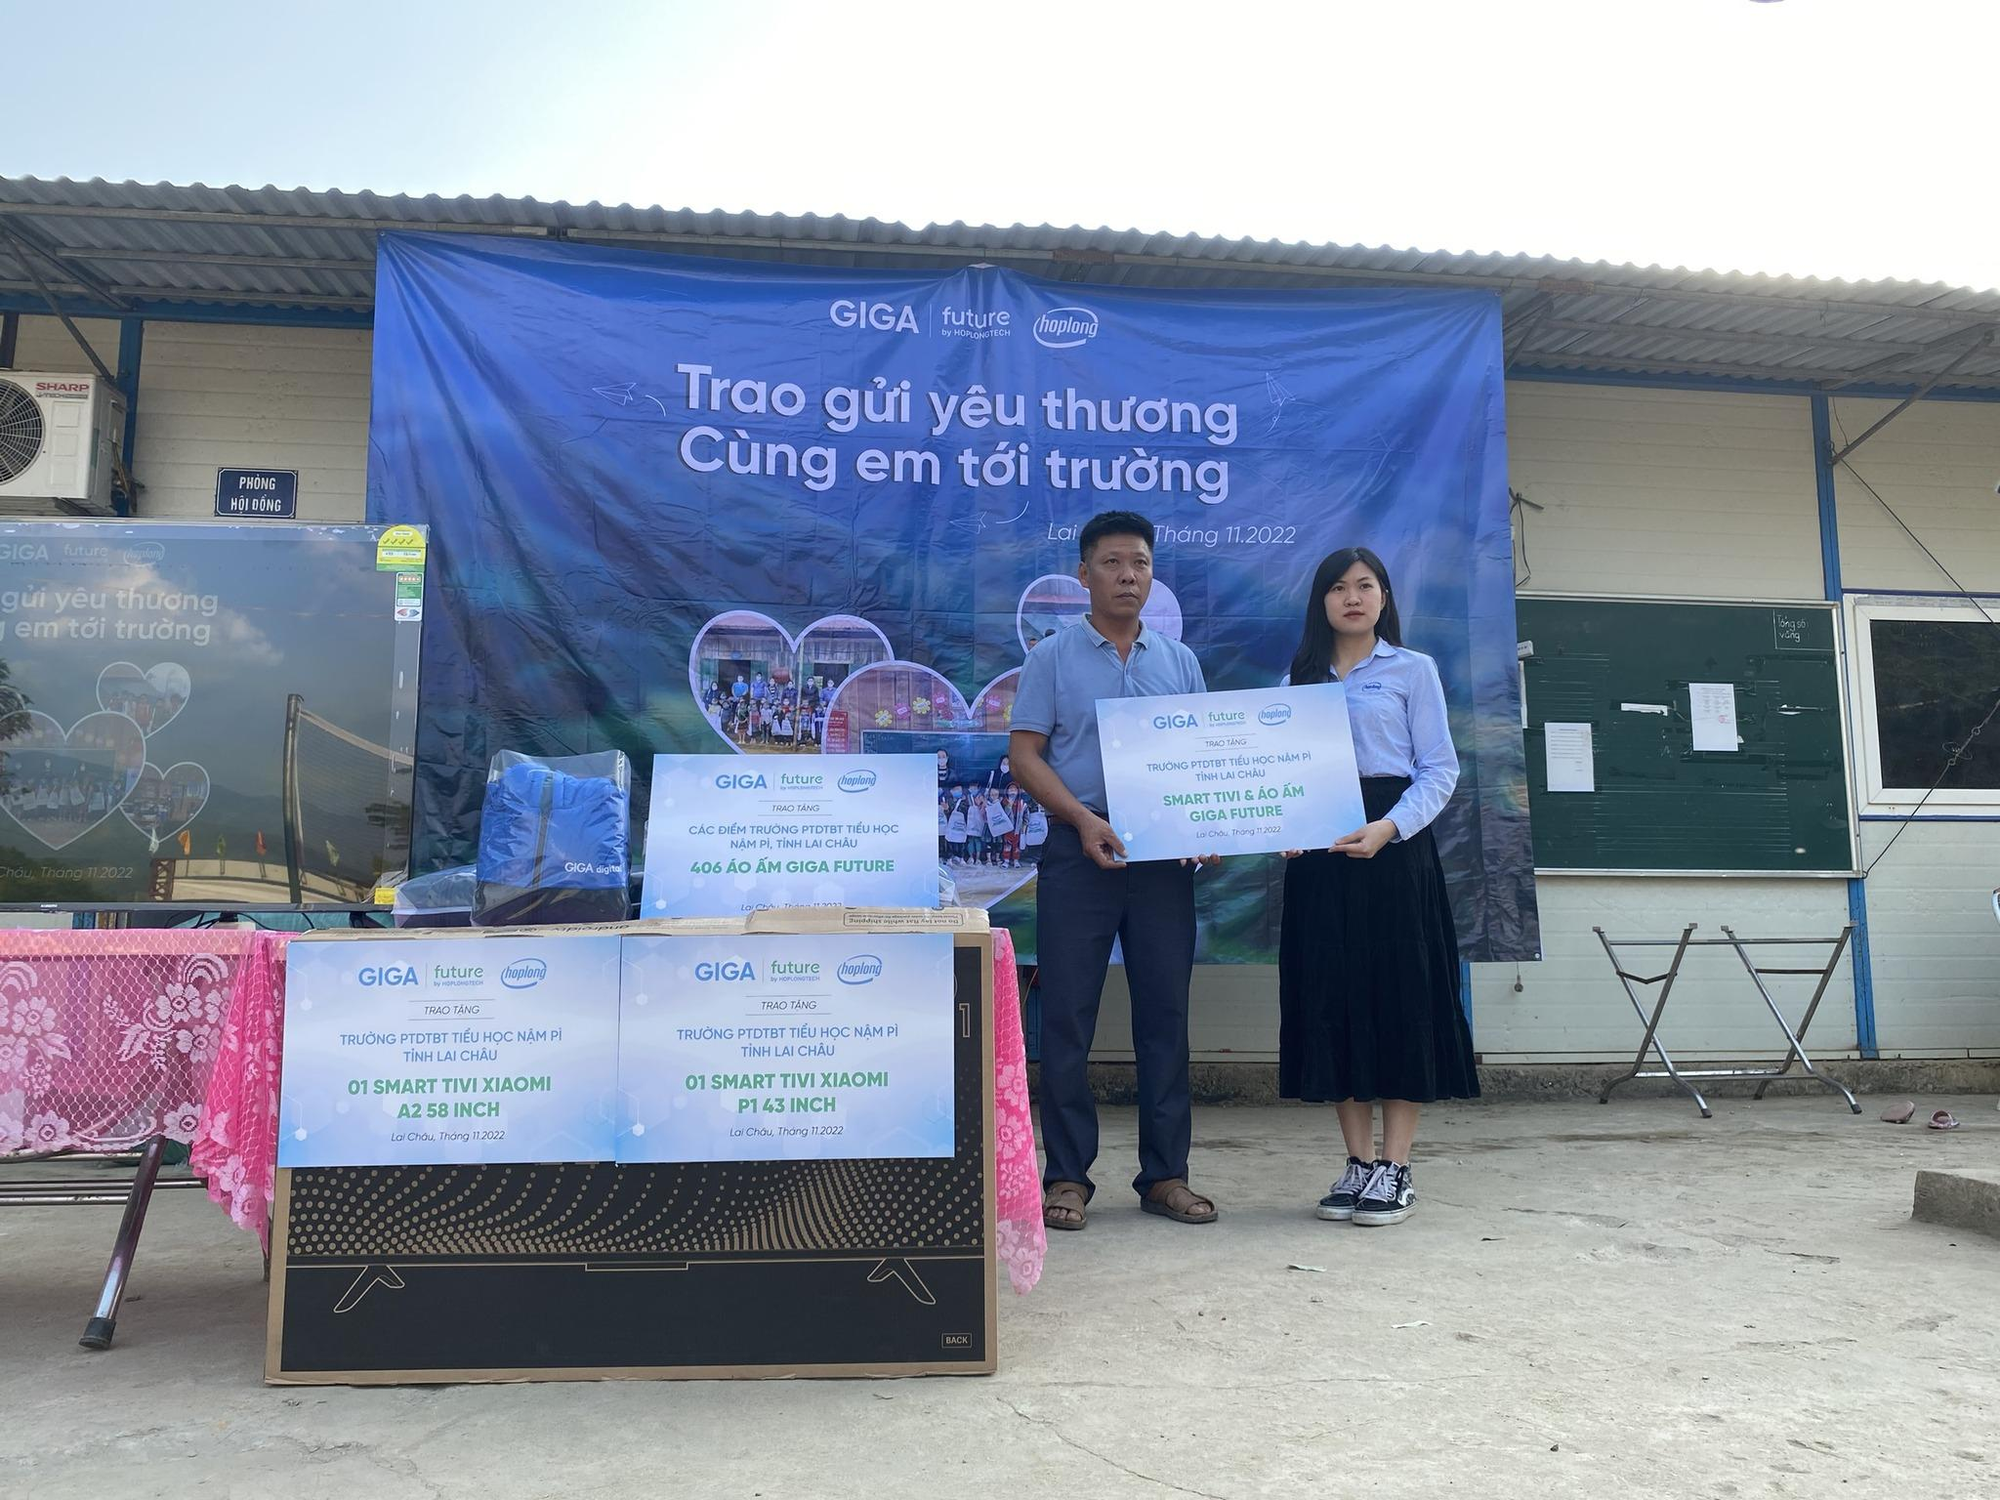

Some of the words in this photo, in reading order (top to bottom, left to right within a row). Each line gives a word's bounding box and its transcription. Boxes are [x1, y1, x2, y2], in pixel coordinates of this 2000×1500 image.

[829, 299, 920, 334] GIGA
[942, 306, 1011, 329] future
[942, 329, 952, 338] by
[953, 329, 1011, 340] HOPLONGTECH
[1038, 316, 1099, 338] hoplong
[35, 382, 90, 392] SHARP
[677, 363, 806, 416] Trao
[823, 376, 911, 433] gửi
[928, 384, 1025, 436] yêu
[1041, 387, 1237, 446] thương
[680, 425, 837, 492] Cùng
[856, 449, 941, 485] em
[958, 441, 1029, 487] tới
[1045, 447, 1229, 504] trường
[239, 473, 276, 490] PHÒNG
[230, 494, 249, 514] HỘI
[252, 493, 282, 512] ĐỒNG
[1047, 522, 1078, 541] Lai
[1153, 524, 1219, 548] Tháng
[1226, 525, 1297, 544] 11.2022
[64, 543, 109, 558] future
[1, 584, 46, 614] gửi
[55, 587, 106, 614] yêu
[115, 588, 219, 617] thương
[15, 620, 59, 639] em
[68, 616, 106, 640] tới
[115, 617, 211, 646] trường
[1153, 713, 1199, 730] GIGA
[1208, 711, 1246, 722] future
[1260, 708, 1292, 720] hoplong
[1205, 740, 1225, 748] TRAO
[1146, 761, 1189, 773] TRƯỜNG
[1190, 758, 1227, 770] PTDTBT
[715, 774, 768, 790] GIGA
[780, 772, 824, 785] future
[840, 774, 877, 788] hoplong
[1220, 770, 1235, 781] LAI
[1237, 768, 1266, 779] CHÂU
[1163, 792, 1211, 807] SMART
[1213, 790, 1241, 804] TIVI
[1244, 789, 1254, 801] &
[1257, 785, 1279, 800] ÁO
[1282, 781, 1305, 798] ẤM
[772, 804, 795, 813] TRAO
[1189, 808, 1228, 823] GIGA
[1230, 805, 1284, 820] FUTURE
[688, 823, 715, 836] CÁC
[718, 821, 747, 835] ĐIỂM
[750, 823, 799, 835] TRƯỜNG
[801, 824, 844, 835] PTDTBT
[846, 821, 870, 834] TIỂU
[873, 823, 899, 836] HỌC
[1196, 831, 1207, 839] Lai
[730, 837, 757, 851] NẬM
[805, 838, 822, 849] LAI
[825, 837, 858, 849] CHÂU
[40, 866, 82, 882] Tháng
[87, 866, 134, 879] 11.2022
[564, 862, 594, 873] GIGA
[690, 860, 723, 875] 406
[726, 858, 752, 875] ÁO
[755, 857, 782, 874] ẤM
[786, 860, 830, 874] GIGA
[833, 859, 895, 873] FUTURE
[433, 964, 484, 979] future
[503, 965, 547, 981] hoplong
[694, 961, 756, 982] GIGA
[770, 960, 821, 974] future
[840, 961, 883, 977] hoplong
[358, 965, 419, 987] GIGA
[424, 1006, 451, 1015] TRAO
[453, 1004, 481, 1017] TẶNG
[761, 1001, 788, 1010] TRAO
[790, 999, 817, 1012] TẶNG
[958, 1002, 970, 1038] 1
[340, 1030, 397, 1046] TRƯỜNG
[400, 1032, 449, 1045] PTDTBT
[451, 1028, 479, 1044] TIỂU
[483, 1031, 514, 1046] HỌC
[517, 1028, 547, 1045] NẬM
[676, 1025, 734, 1041] TRƯỜNG
[737, 1027, 786, 1040] PTDTBT
[789, 1023, 817, 1039] TIỂU
[820, 1026, 850, 1041] HỌC
[854, 1023, 884, 1041] NẬM
[887, 1023, 899, 1038] PÌ
[403, 1048, 433, 1063] TỈNH
[437, 1050, 456, 1062] LAI
[460, 1047, 498, 1062] CHÂU
[741, 1043, 771, 1058] TỈNH
[774, 1045, 794, 1057] LAI
[797, 1042, 836, 1057] CHÂU
[347, 1079, 369, 1096] 01
[373, 1078, 438, 1095] SMART
[442, 1077, 478, 1094] TIVI
[481, 1076, 552, 1093] XIAOMI
[685, 1074, 706, 1091] 01
[710, 1073, 776, 1090] SMART
[780, 1072, 816, 1089] TIVI
[820, 1071, 889, 1088] XIAOMI
[397, 1103, 422, 1119] A2
[426, 1102, 449, 1118] 58
[453, 1101, 500, 1118] INCH
[738, 1098, 758, 1114] P1
[762, 1097, 785, 1113] 43
[790, 1096, 837, 1113] INCH
[390, 1132, 406, 1142] Lai
[408, 1131, 436, 1143] Châu,
[439, 1131, 470, 1143] Tháng
[472, 1130, 506, 1141] 11.2022
[729, 1127, 744, 1137] Lai
[746, 1126, 775, 1138] Châu,
[777, 1126, 808, 1138] Tháng
[811, 1125, 844, 1136] 11.2022
[945, 1336, 968, 1344] BACK
